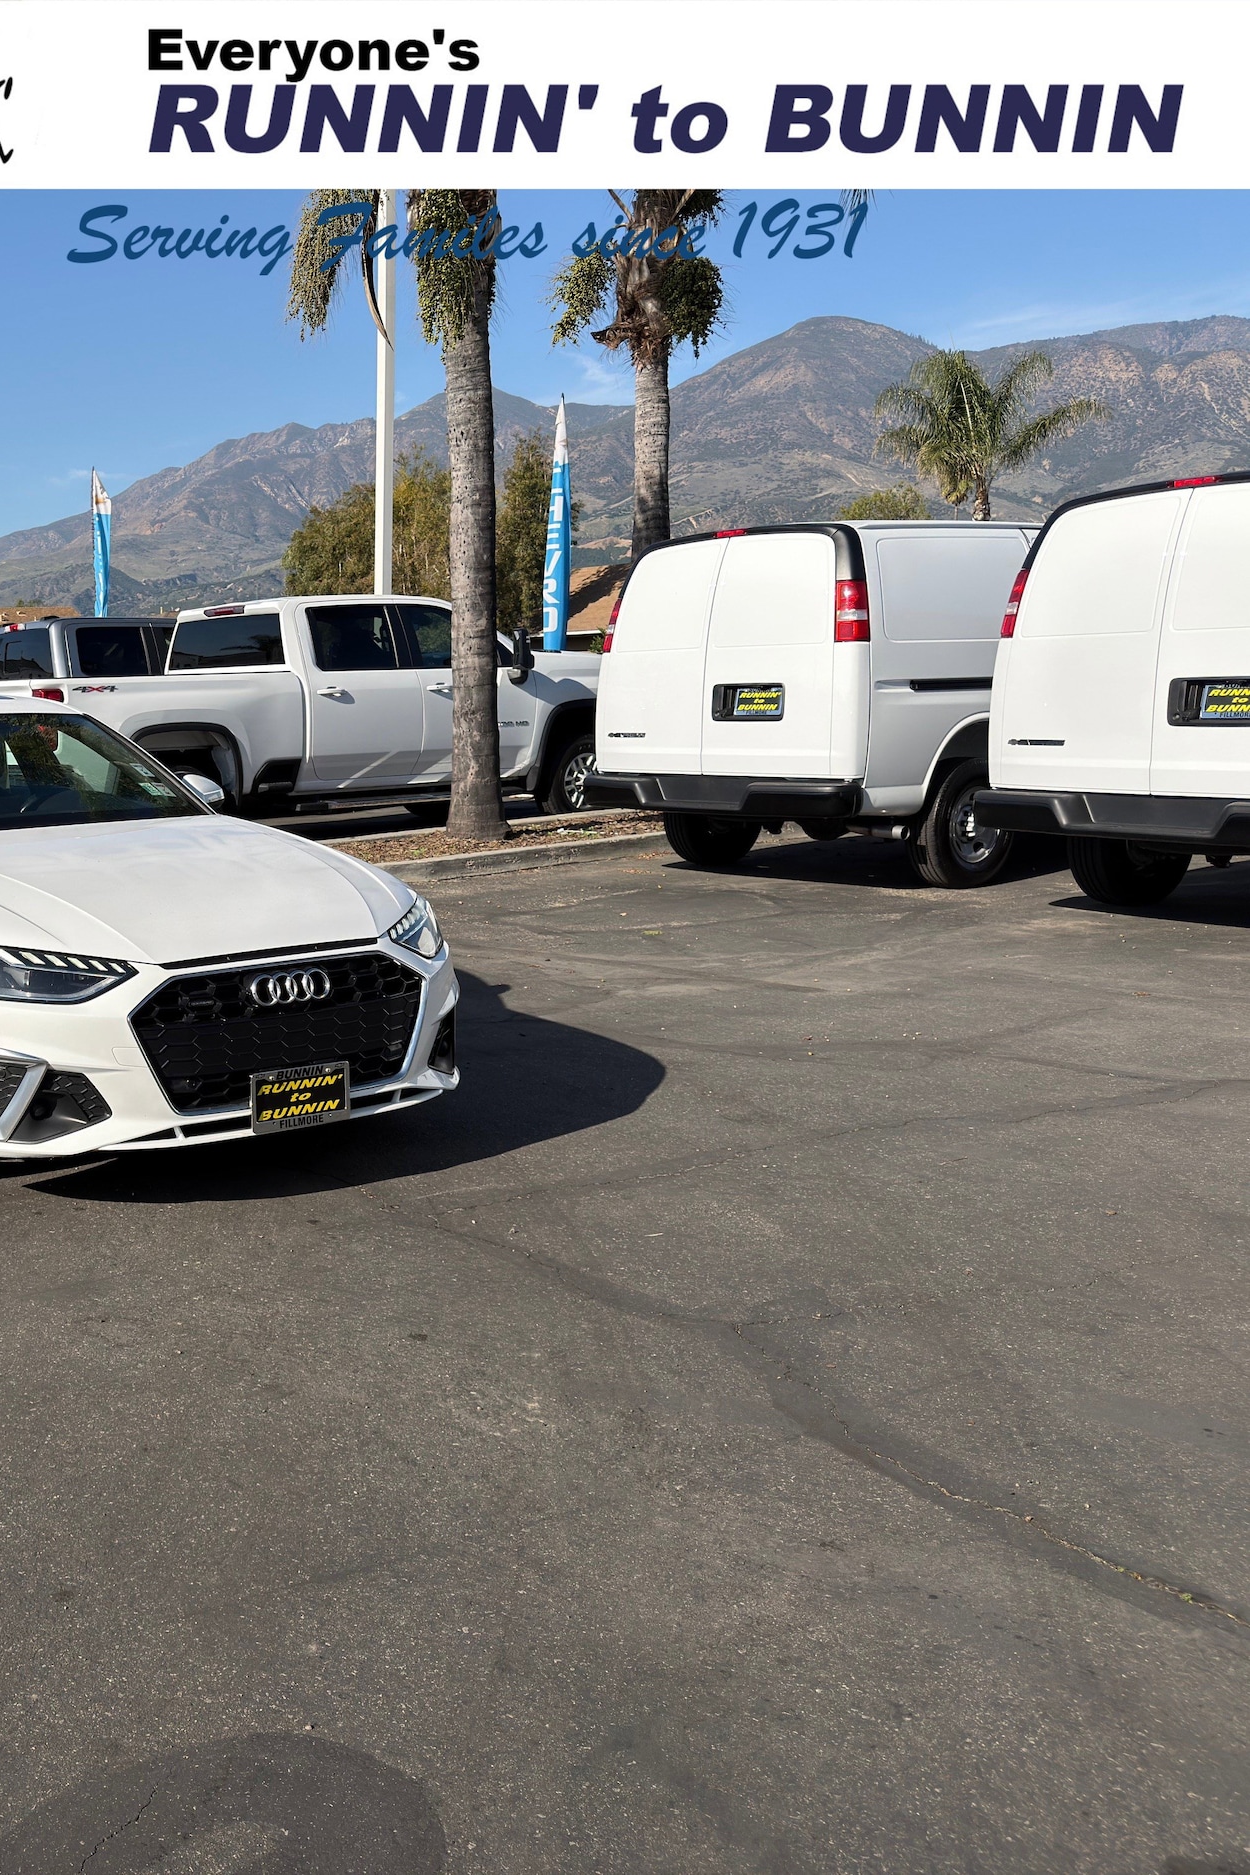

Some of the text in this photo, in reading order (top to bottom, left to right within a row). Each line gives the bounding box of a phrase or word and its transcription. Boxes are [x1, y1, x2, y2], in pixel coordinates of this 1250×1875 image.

[737, 703, 778, 711] BUNNIN
[276, 1066, 324, 1080] BUNNIN
[257, 1074, 343, 1096] RUNNIN'
[290, 1092, 311, 1102] to
[258, 1099, 340, 1121] BUNNIN
[279, 1113, 324, 1129] FILLMORE
